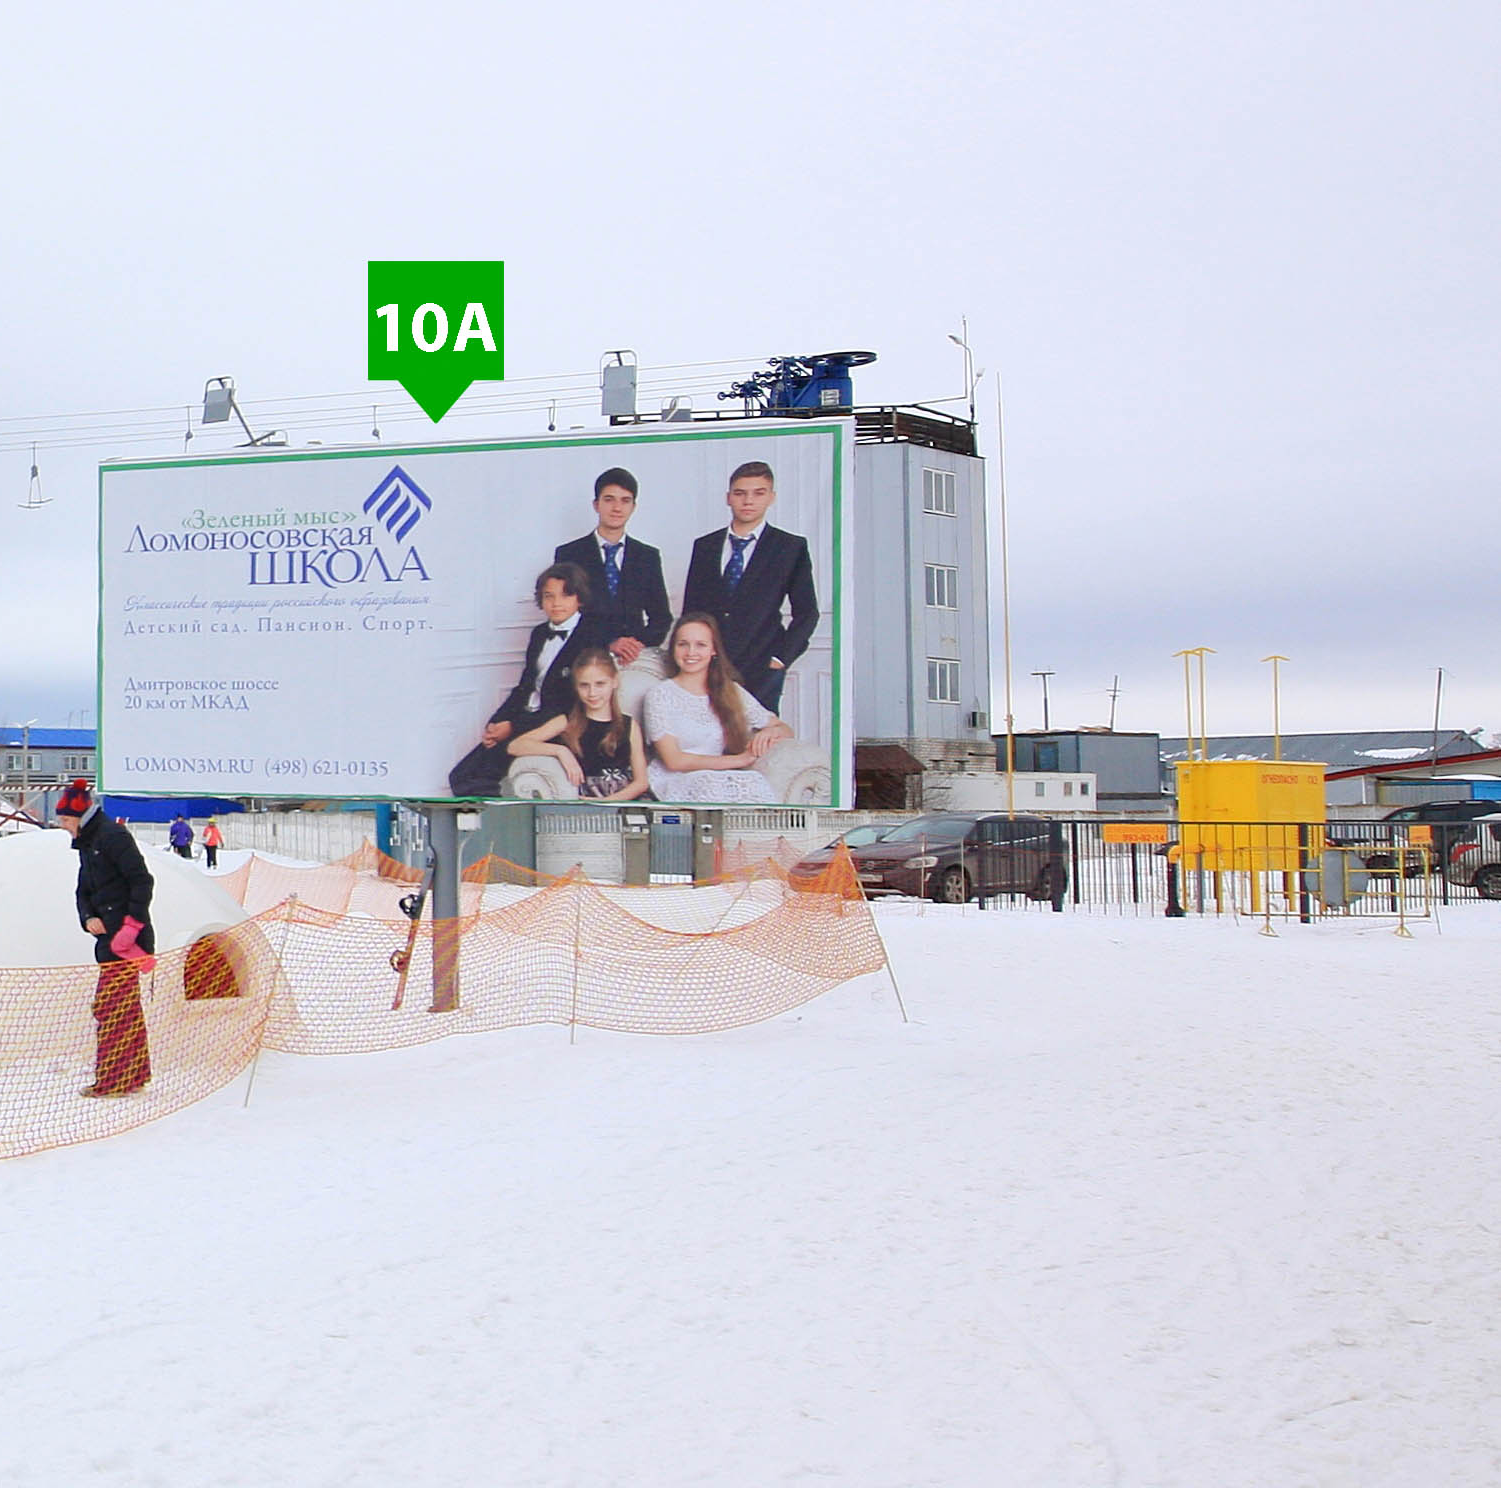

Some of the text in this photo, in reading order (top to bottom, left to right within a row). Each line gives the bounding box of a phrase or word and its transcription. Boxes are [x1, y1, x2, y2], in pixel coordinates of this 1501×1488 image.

[181, 508, 357, 530] «Зеленый мыс»
[124, 523, 373, 553] Ломоносовская
[248, 546, 432, 588] ШКОЛА
[124, 616, 434, 636] Детский сад. Пансион. Спорт.
[124, 677, 279, 694] Дмитровское шоссе
[124, 695, 249, 712] 20 км от МКАД
[125, 756, 388, 777] LOMON3M.RU (498) 621-0135
